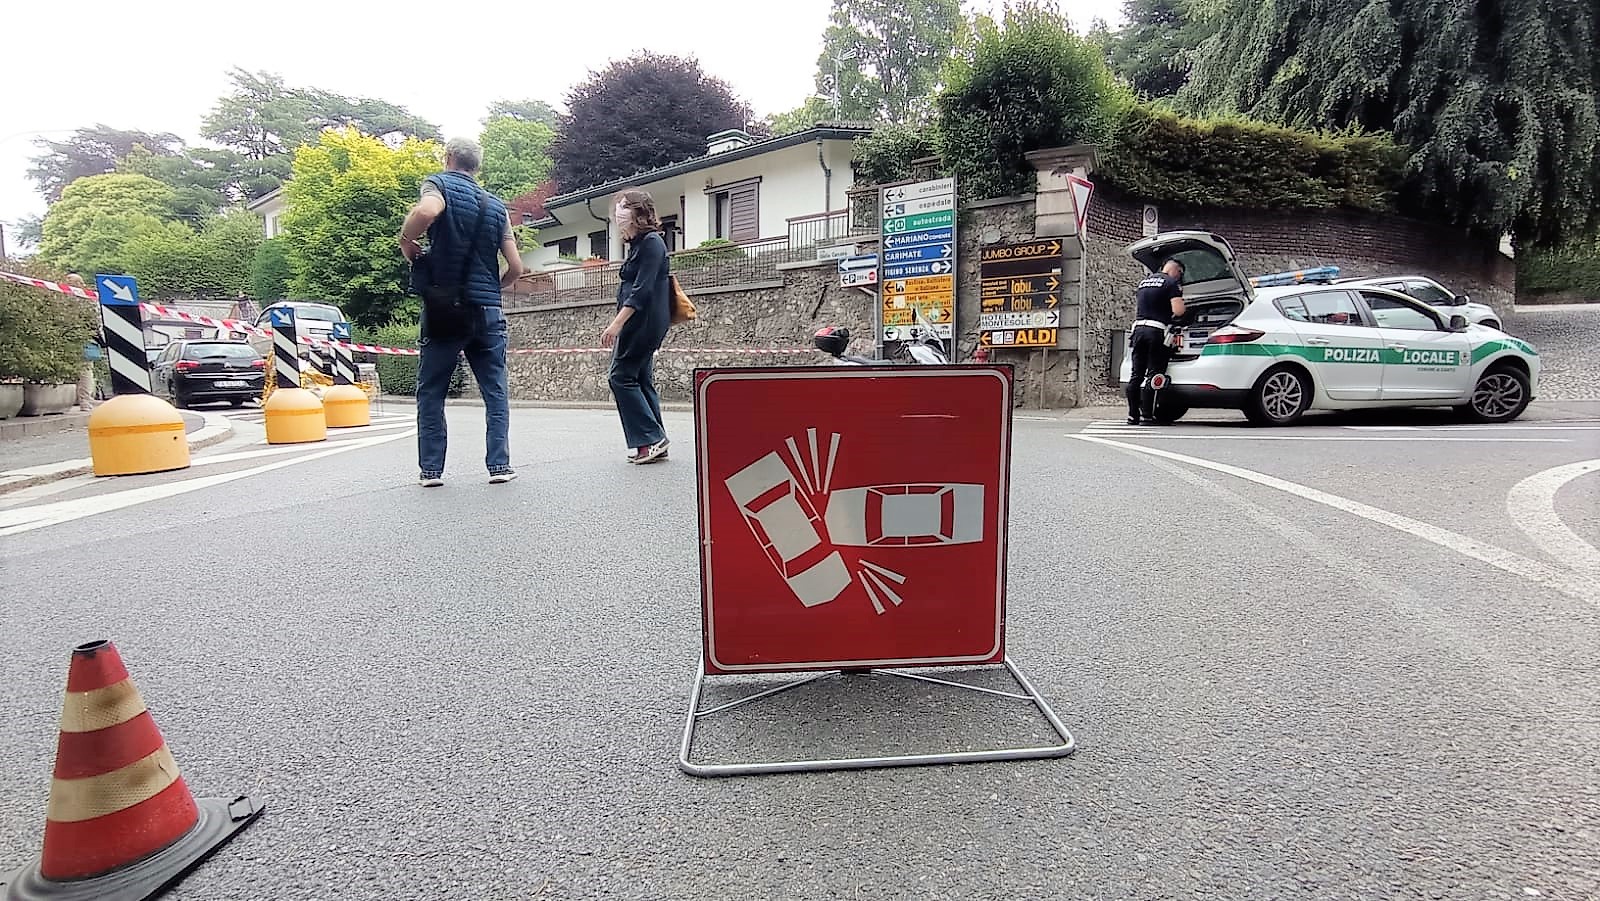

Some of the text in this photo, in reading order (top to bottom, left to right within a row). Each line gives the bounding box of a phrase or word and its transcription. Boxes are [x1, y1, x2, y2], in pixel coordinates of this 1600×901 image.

[913, 215, 951, 226] autostrada
[894, 234, 929, 245] MARIANO
[885, 250, 922, 260] CARIMATE
[982, 245, 1046, 259] JUMBO GROUP
[981, 313, 1008, 321] HOTEL
[981, 319, 1032, 327] MONTESOLE
[1015, 329, 1057, 344] ALDI
[1324, 349, 1455, 364] POLIZIA LOCALE
